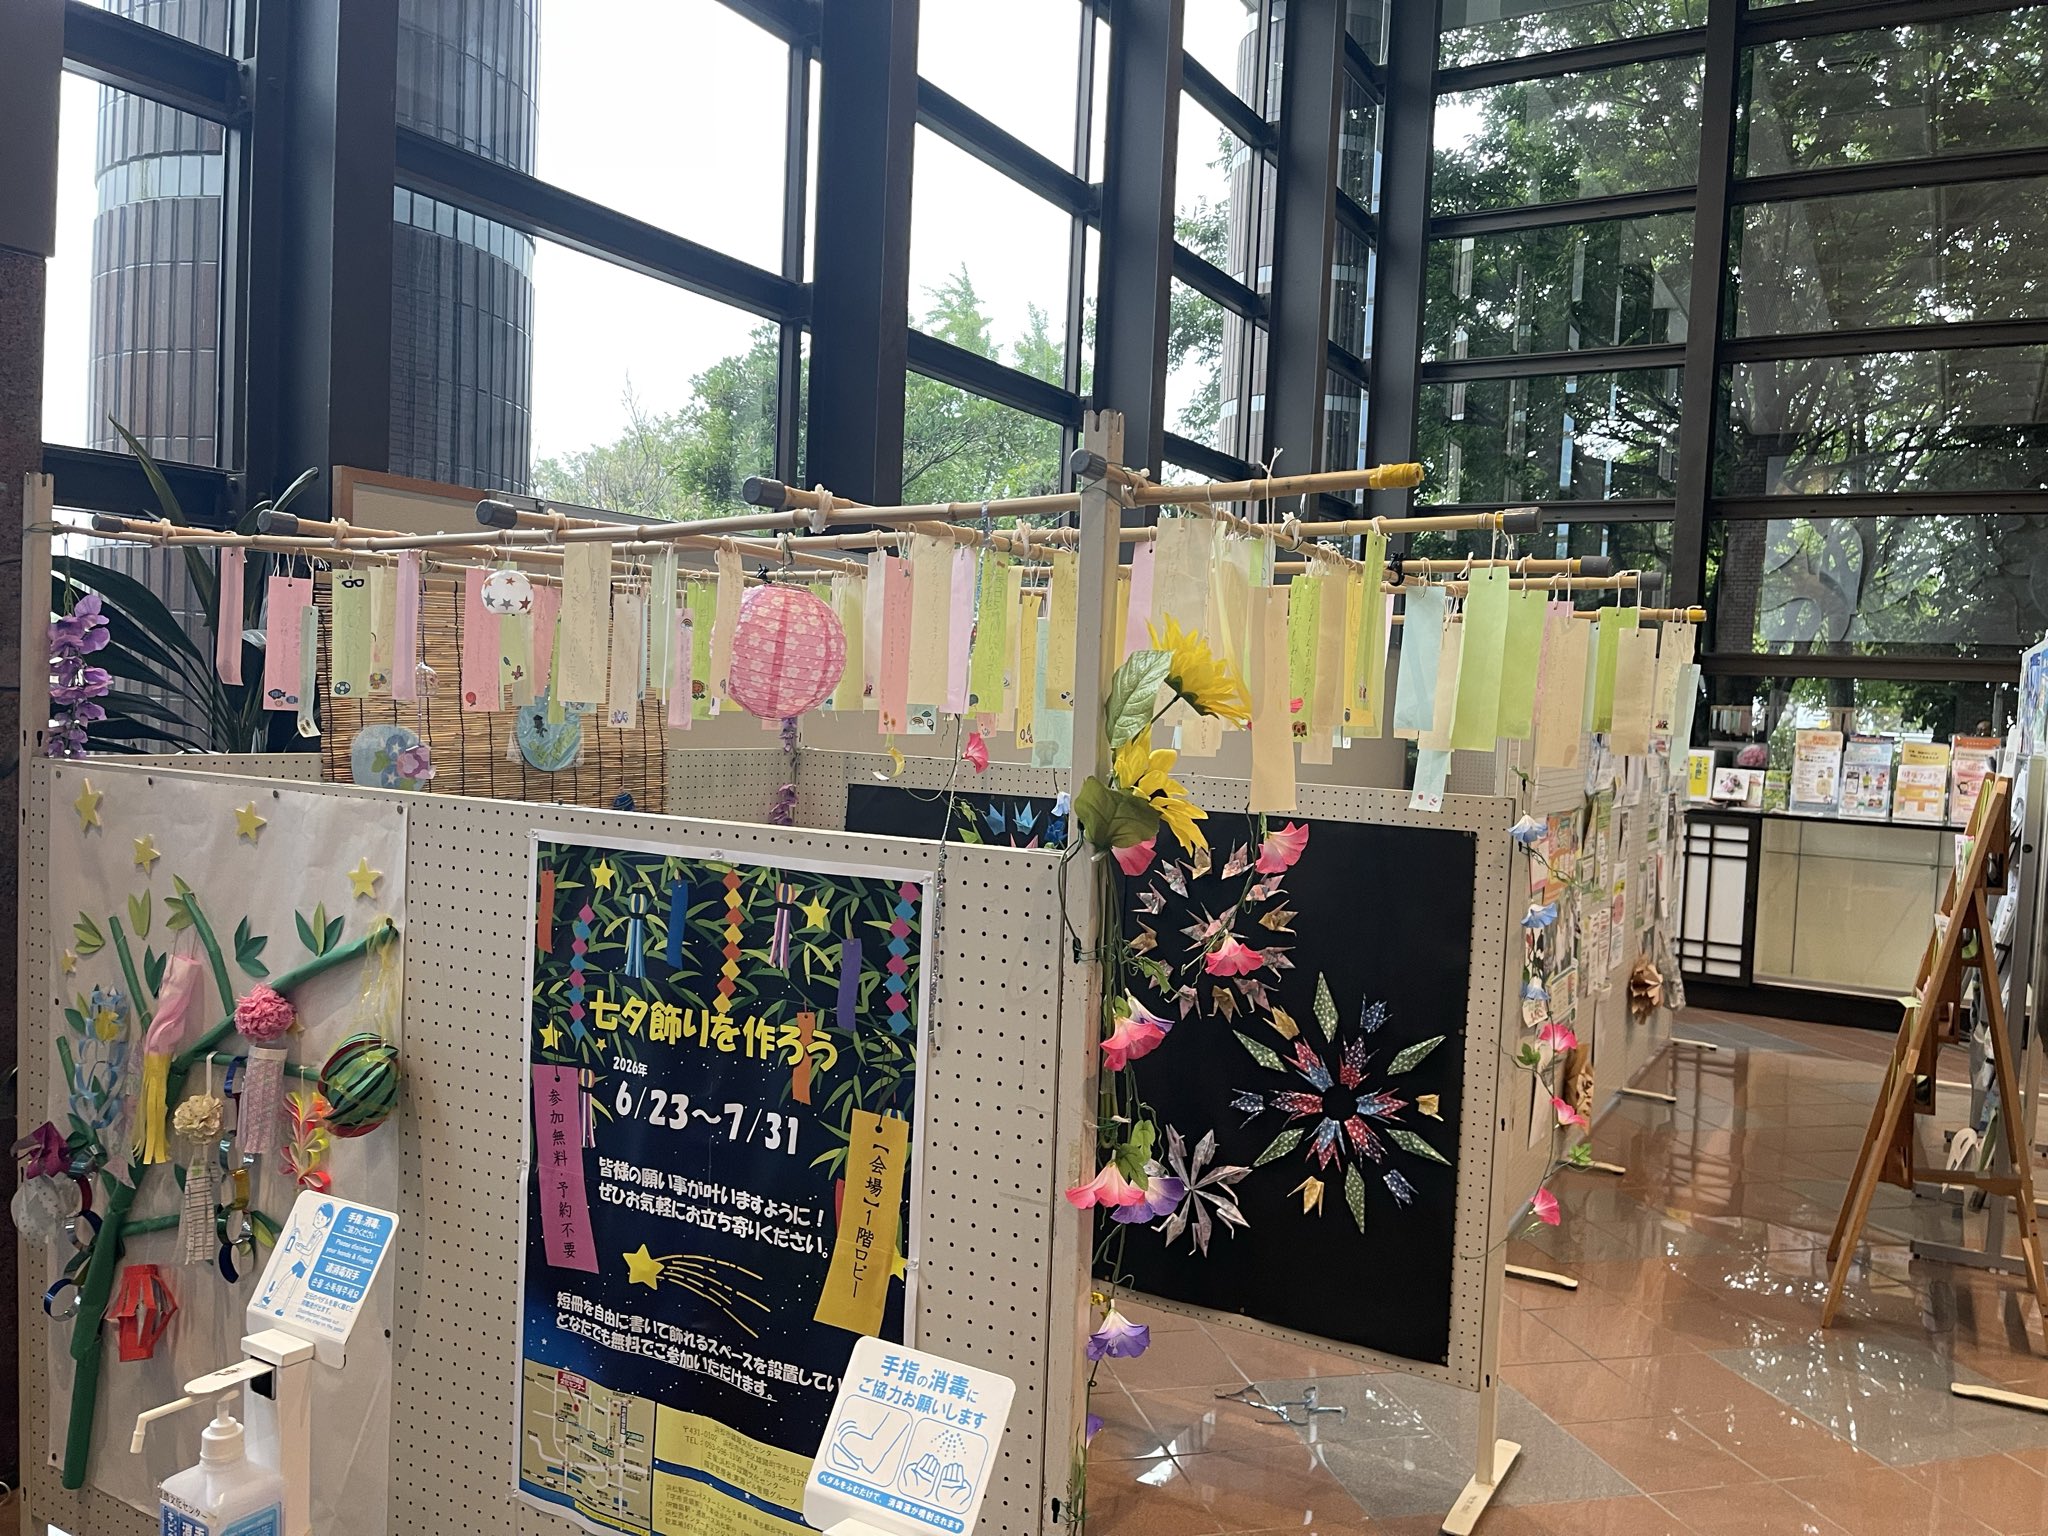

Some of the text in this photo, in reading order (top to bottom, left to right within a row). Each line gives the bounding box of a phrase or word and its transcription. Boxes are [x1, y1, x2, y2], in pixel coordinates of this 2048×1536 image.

[589, 989, 838, 1072] 七夕飾りを作ろう
[613, 1056, 648, 1077] 2026年
[547, 1089, 577, 1258] 参加無料・予約不要
[598, 1157, 824, 1228] 皆様の願い事が叶いますように！
[598, 1183, 829, 1258] ぜひお気軽にお立ち寄りください。
[556, 1313, 775, 1399] どなたでも無料でご参加いただけます。
[881, 1355, 979, 1404] 手指の消毒に
[858, 1377, 988, 1429] ご協力お願いします
